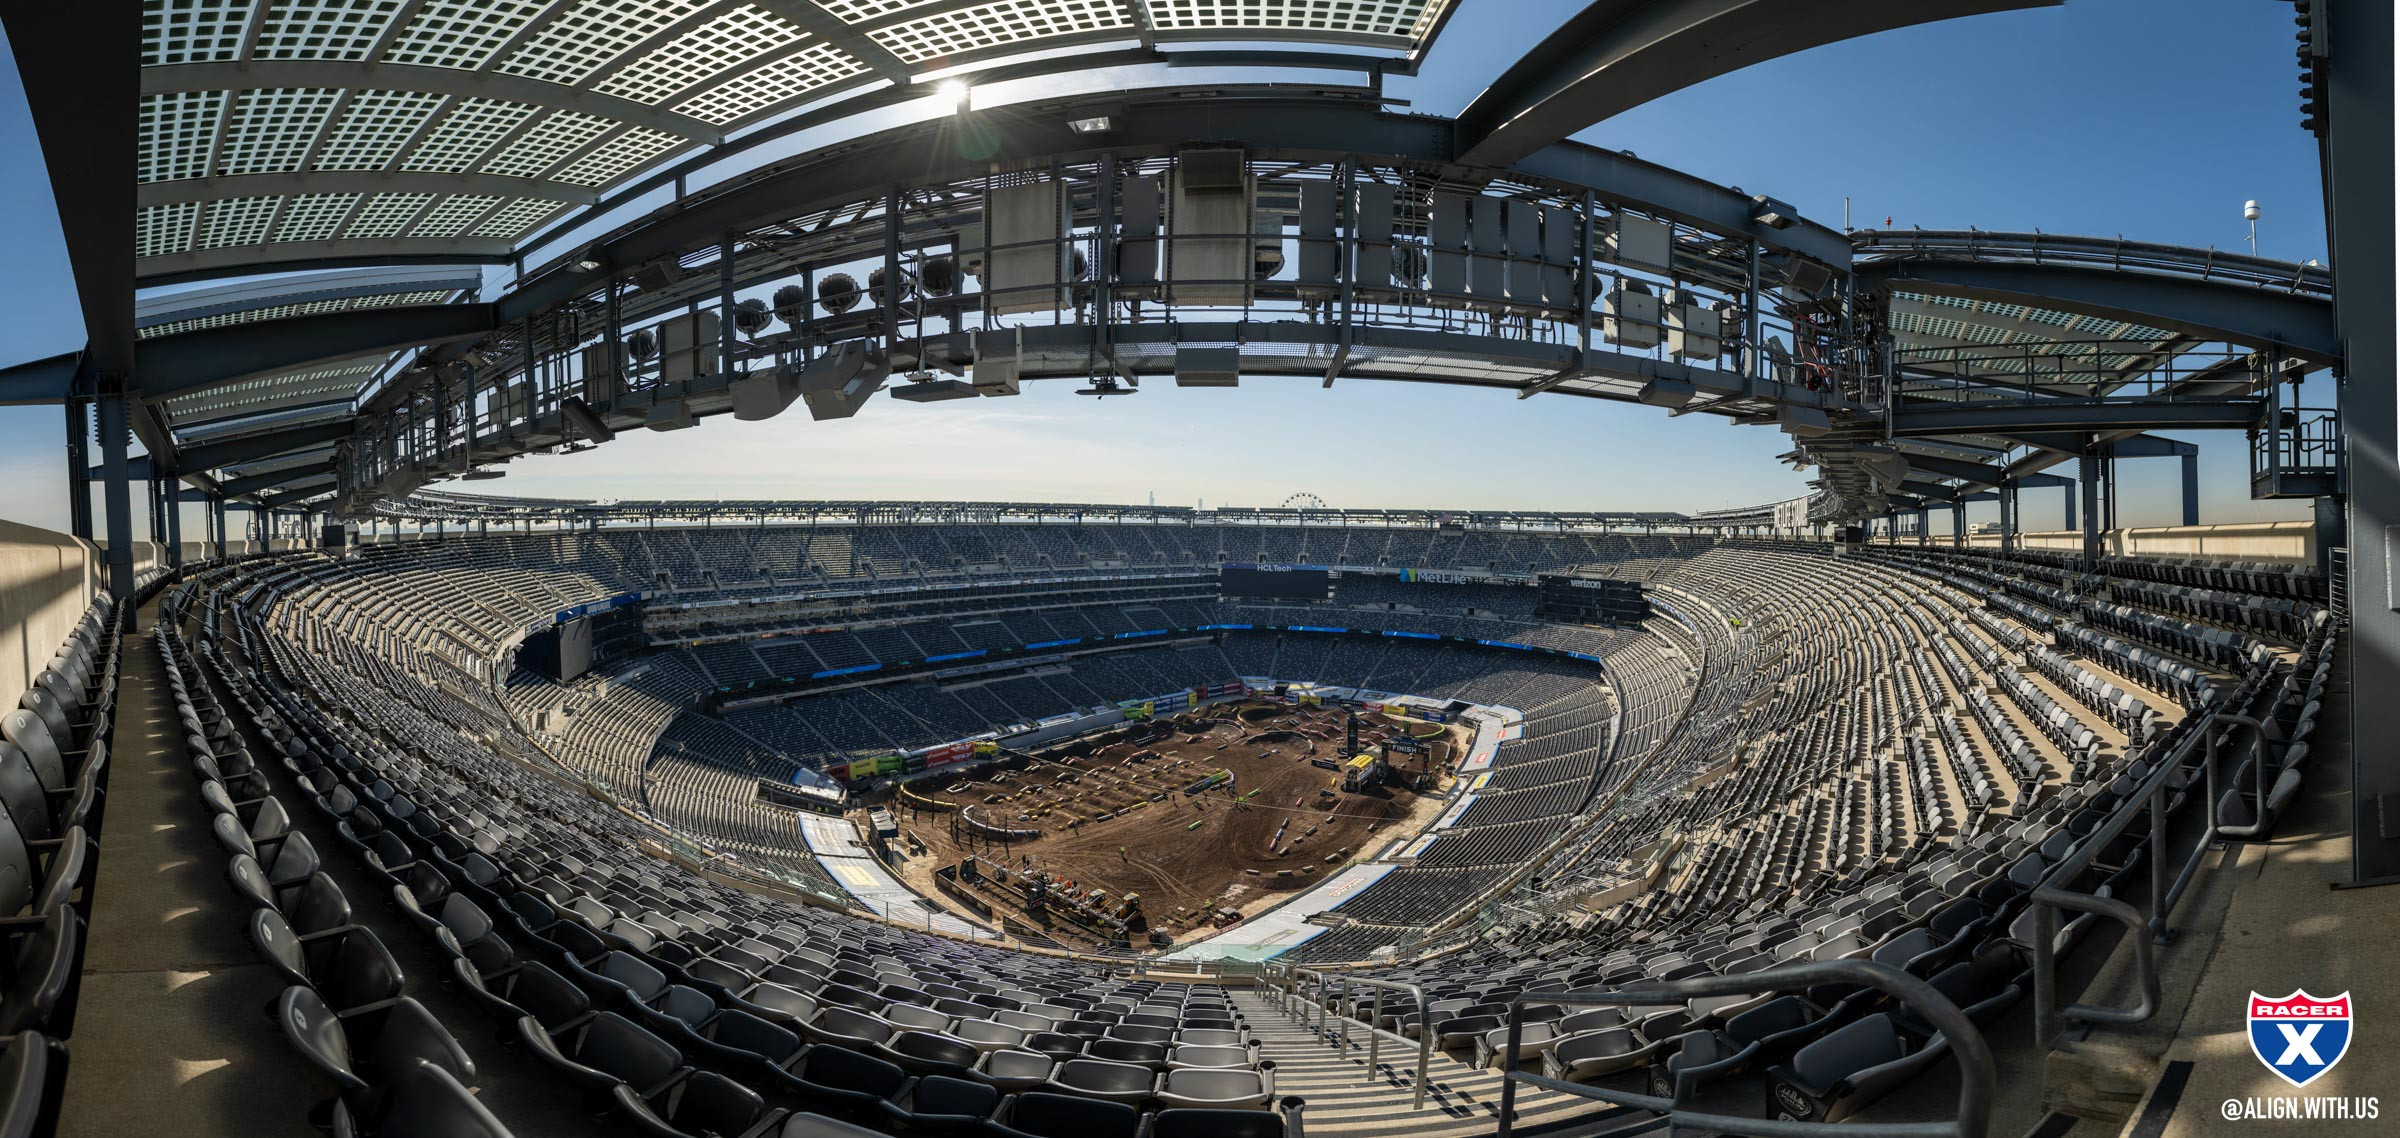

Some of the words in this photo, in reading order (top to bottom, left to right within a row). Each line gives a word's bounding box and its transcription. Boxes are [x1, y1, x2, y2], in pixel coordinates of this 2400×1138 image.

[1257, 564, 1292, 573] HCLTech
[1417, 571, 1467, 585] MetLife
[1570, 578, 1602, 589] verizon
[1392, 744, 1417, 754] FINISH
